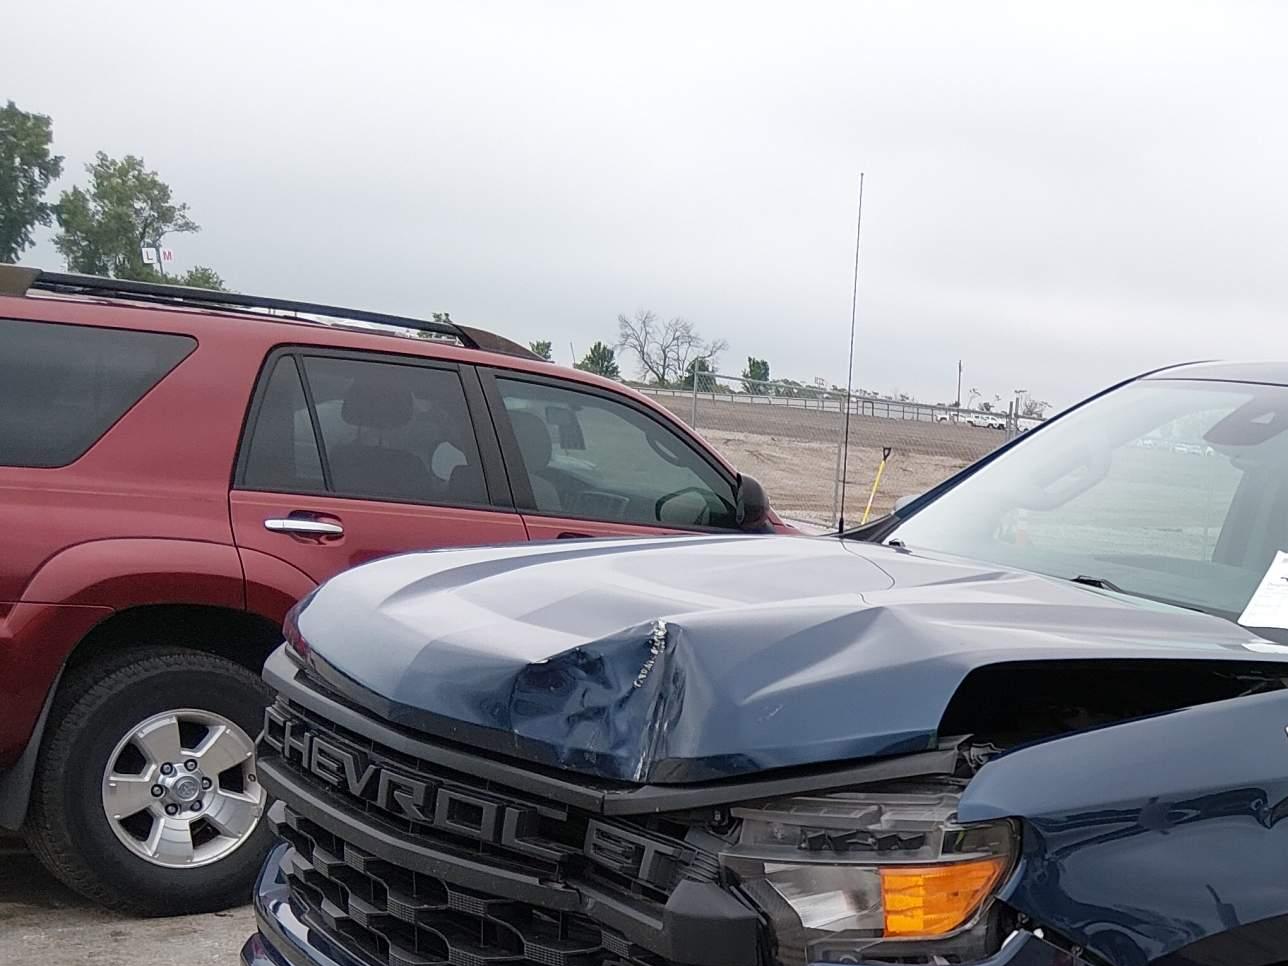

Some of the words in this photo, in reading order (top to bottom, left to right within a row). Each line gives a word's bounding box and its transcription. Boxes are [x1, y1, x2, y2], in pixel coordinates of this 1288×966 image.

[145, 250, 154, 261] L
[162, 250, 173, 261] M
[263, 705, 681, 882] CHEVROLET
